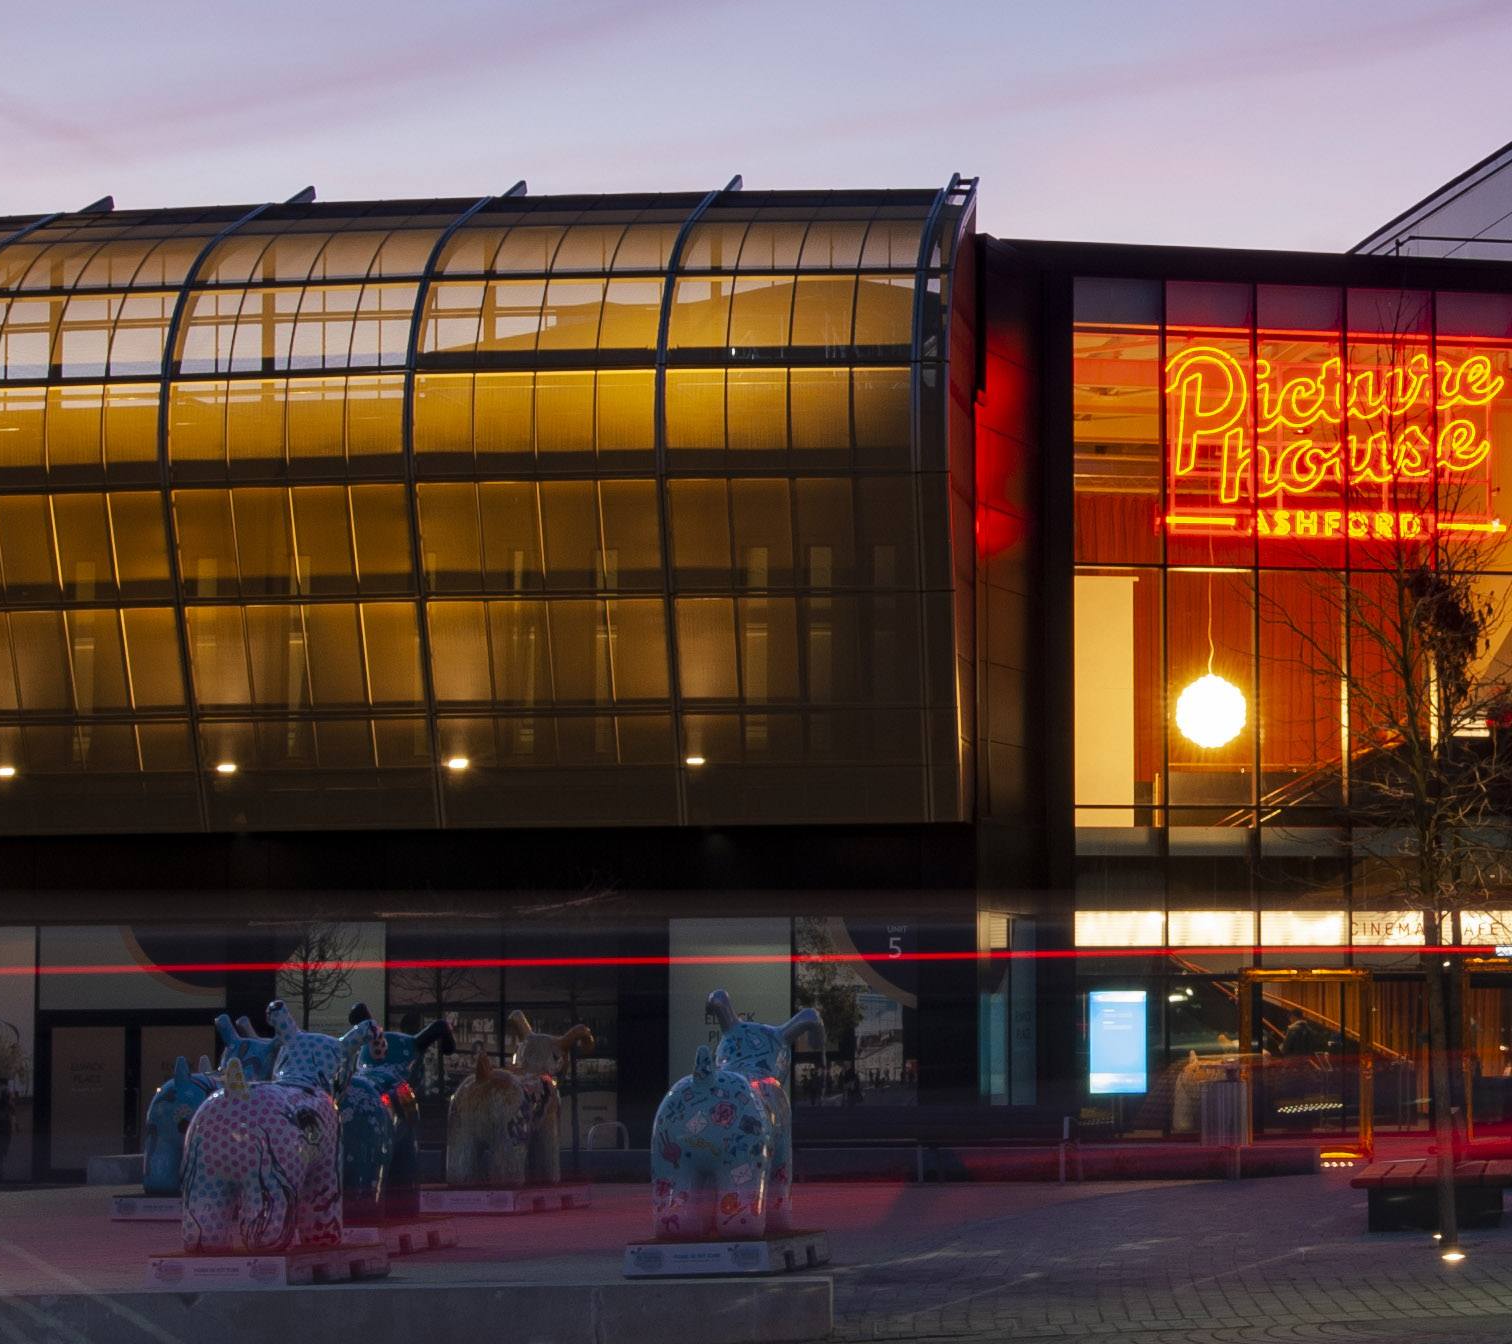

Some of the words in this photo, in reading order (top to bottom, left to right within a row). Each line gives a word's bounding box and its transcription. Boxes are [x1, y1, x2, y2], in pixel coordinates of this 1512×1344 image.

[1165, 346, 1504, 475] Picture
[1255, 510, 1422, 538] ASHFORD
[1351, 922, 1425, 936] CINEMA
[1462, 922, 1498, 936] AFE
[889, 937, 902, 959] 5
